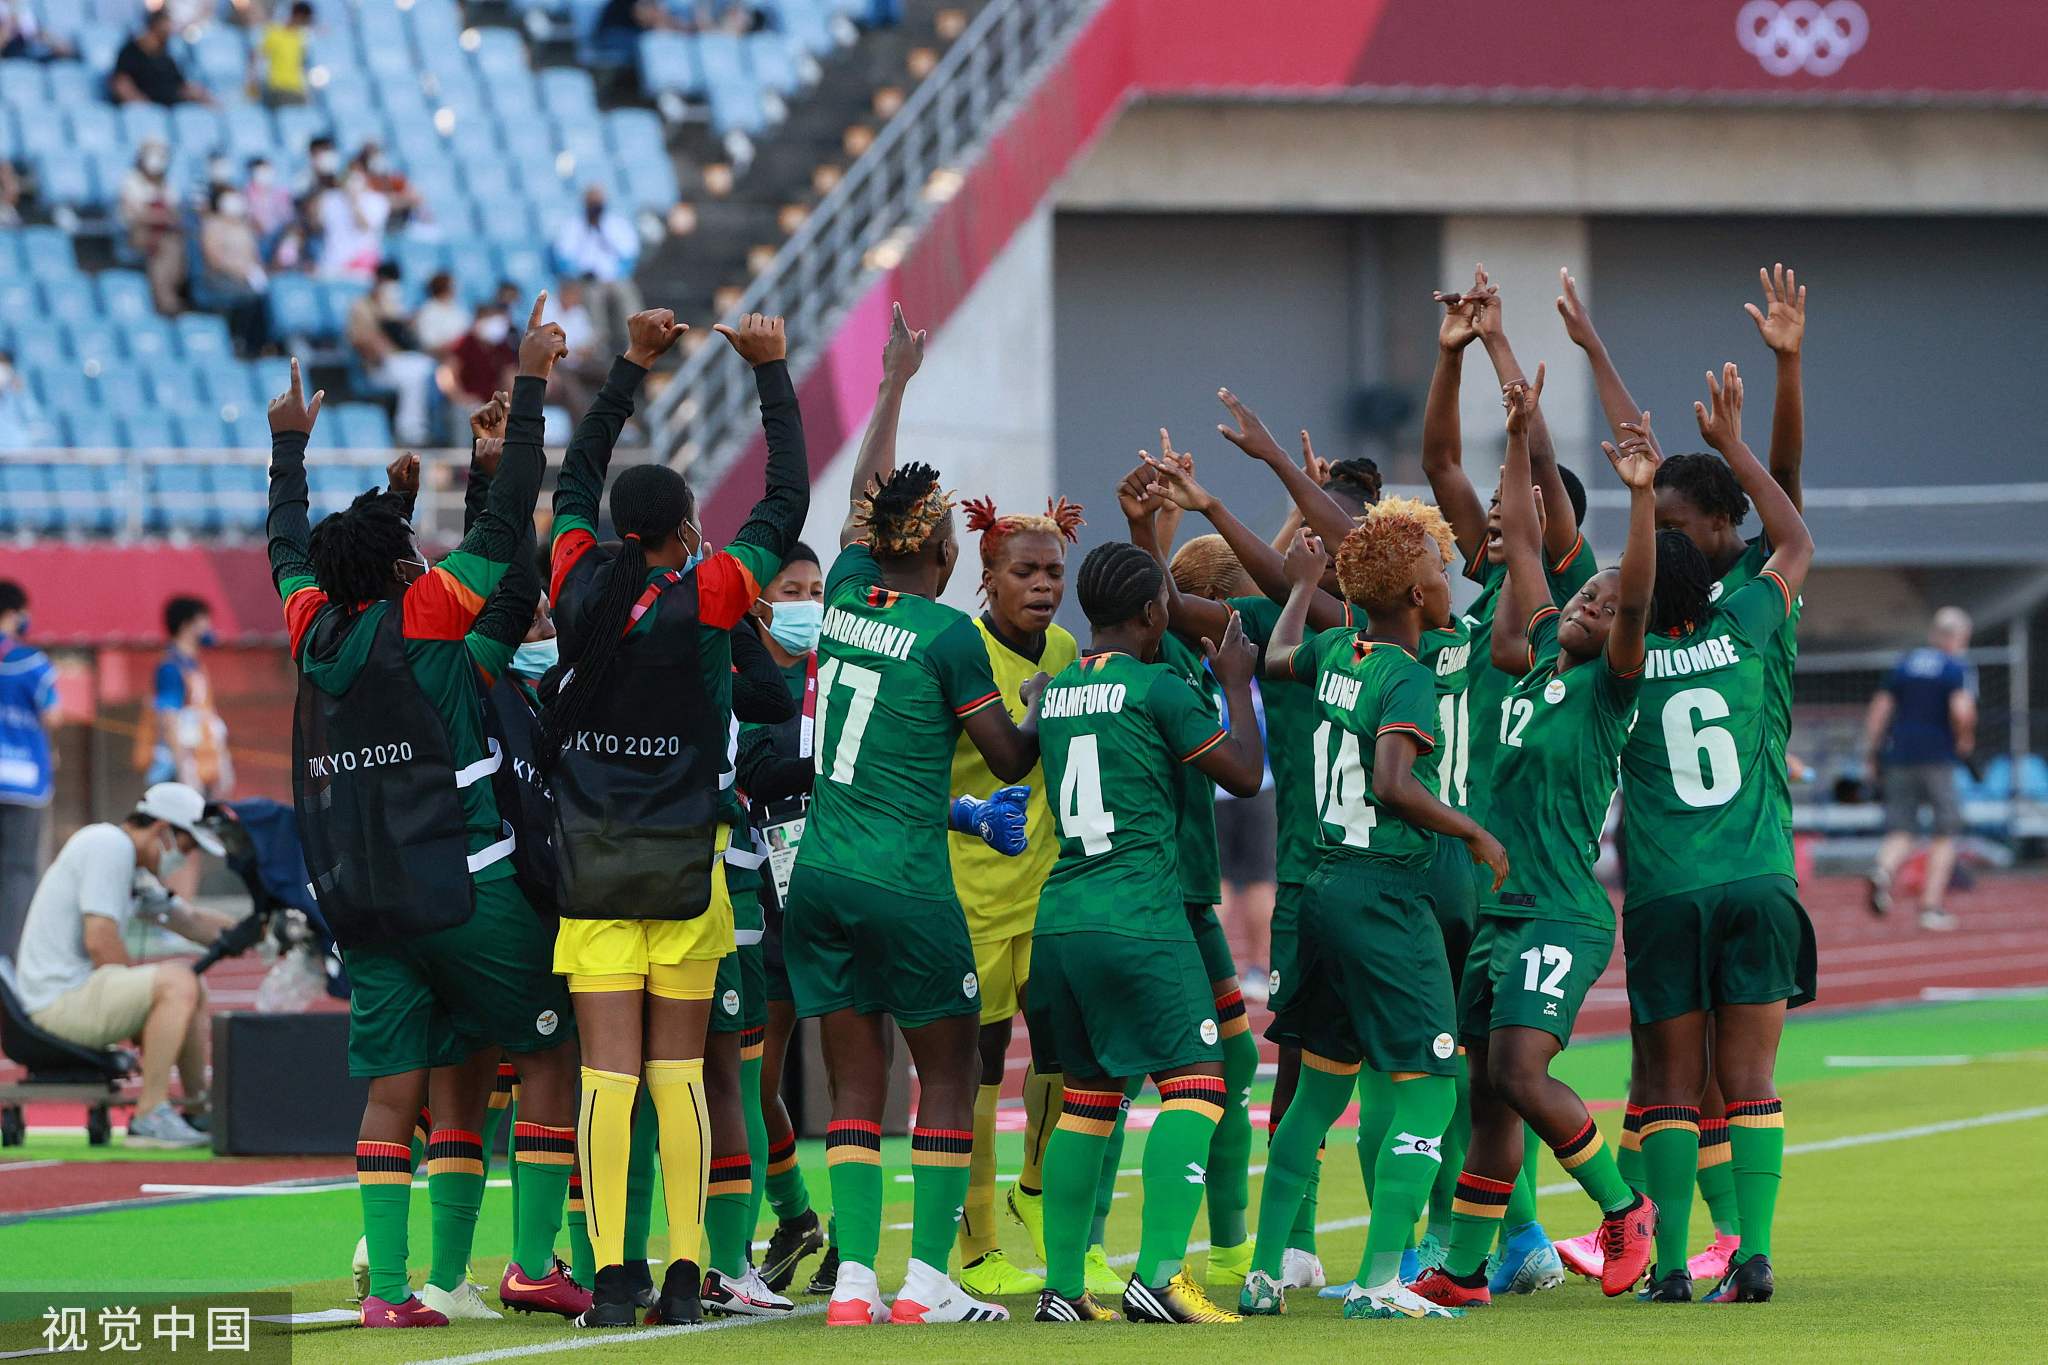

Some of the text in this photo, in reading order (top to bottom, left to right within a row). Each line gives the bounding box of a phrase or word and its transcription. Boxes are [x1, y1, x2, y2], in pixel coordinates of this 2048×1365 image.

[815, 656, 881, 785] 17
[1041, 683, 1126, 719] SIAMFUKO
[1499, 696, 1534, 748] 12
[308, 741, 413, 778] TOKYO 2020
[624, 736, 679, 757] 2020
[1661, 687, 1741, 808] 6
[1059, 733, 1115, 857] 4
[1313, 719, 1377, 848] 14
[1520, 943, 1573, 999] 12
